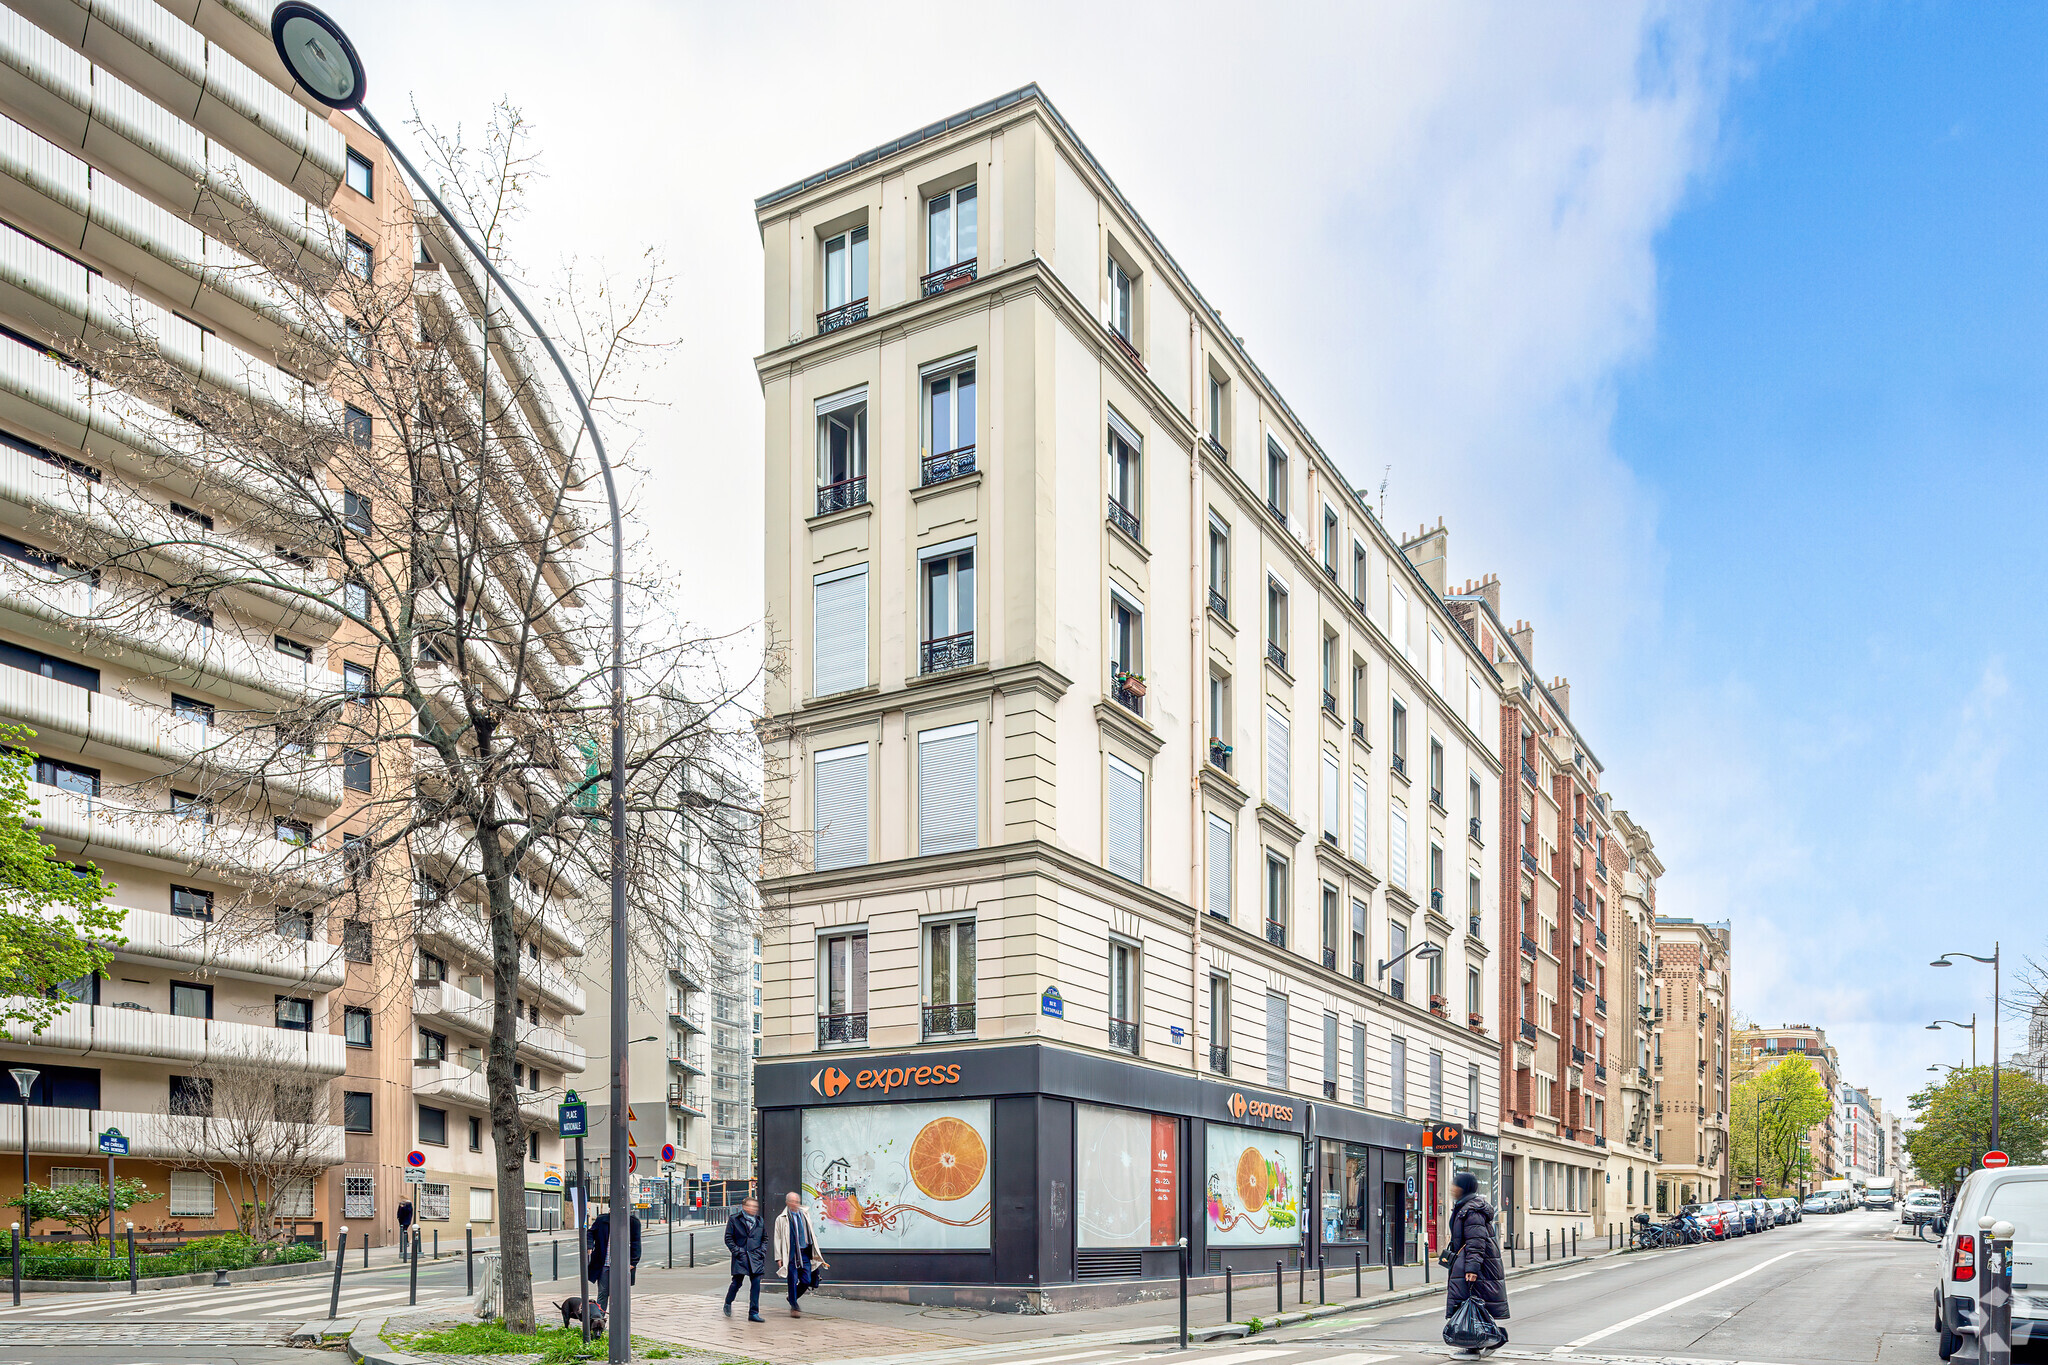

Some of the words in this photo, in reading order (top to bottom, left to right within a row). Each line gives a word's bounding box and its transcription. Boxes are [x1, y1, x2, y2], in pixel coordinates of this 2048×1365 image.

[855, 1063, 961, 1094] express
[566, 1110, 578, 1119] PLACE
[1249, 1100, 1294, 1122] express
[563, 1121, 582, 1131] NATIONALE
